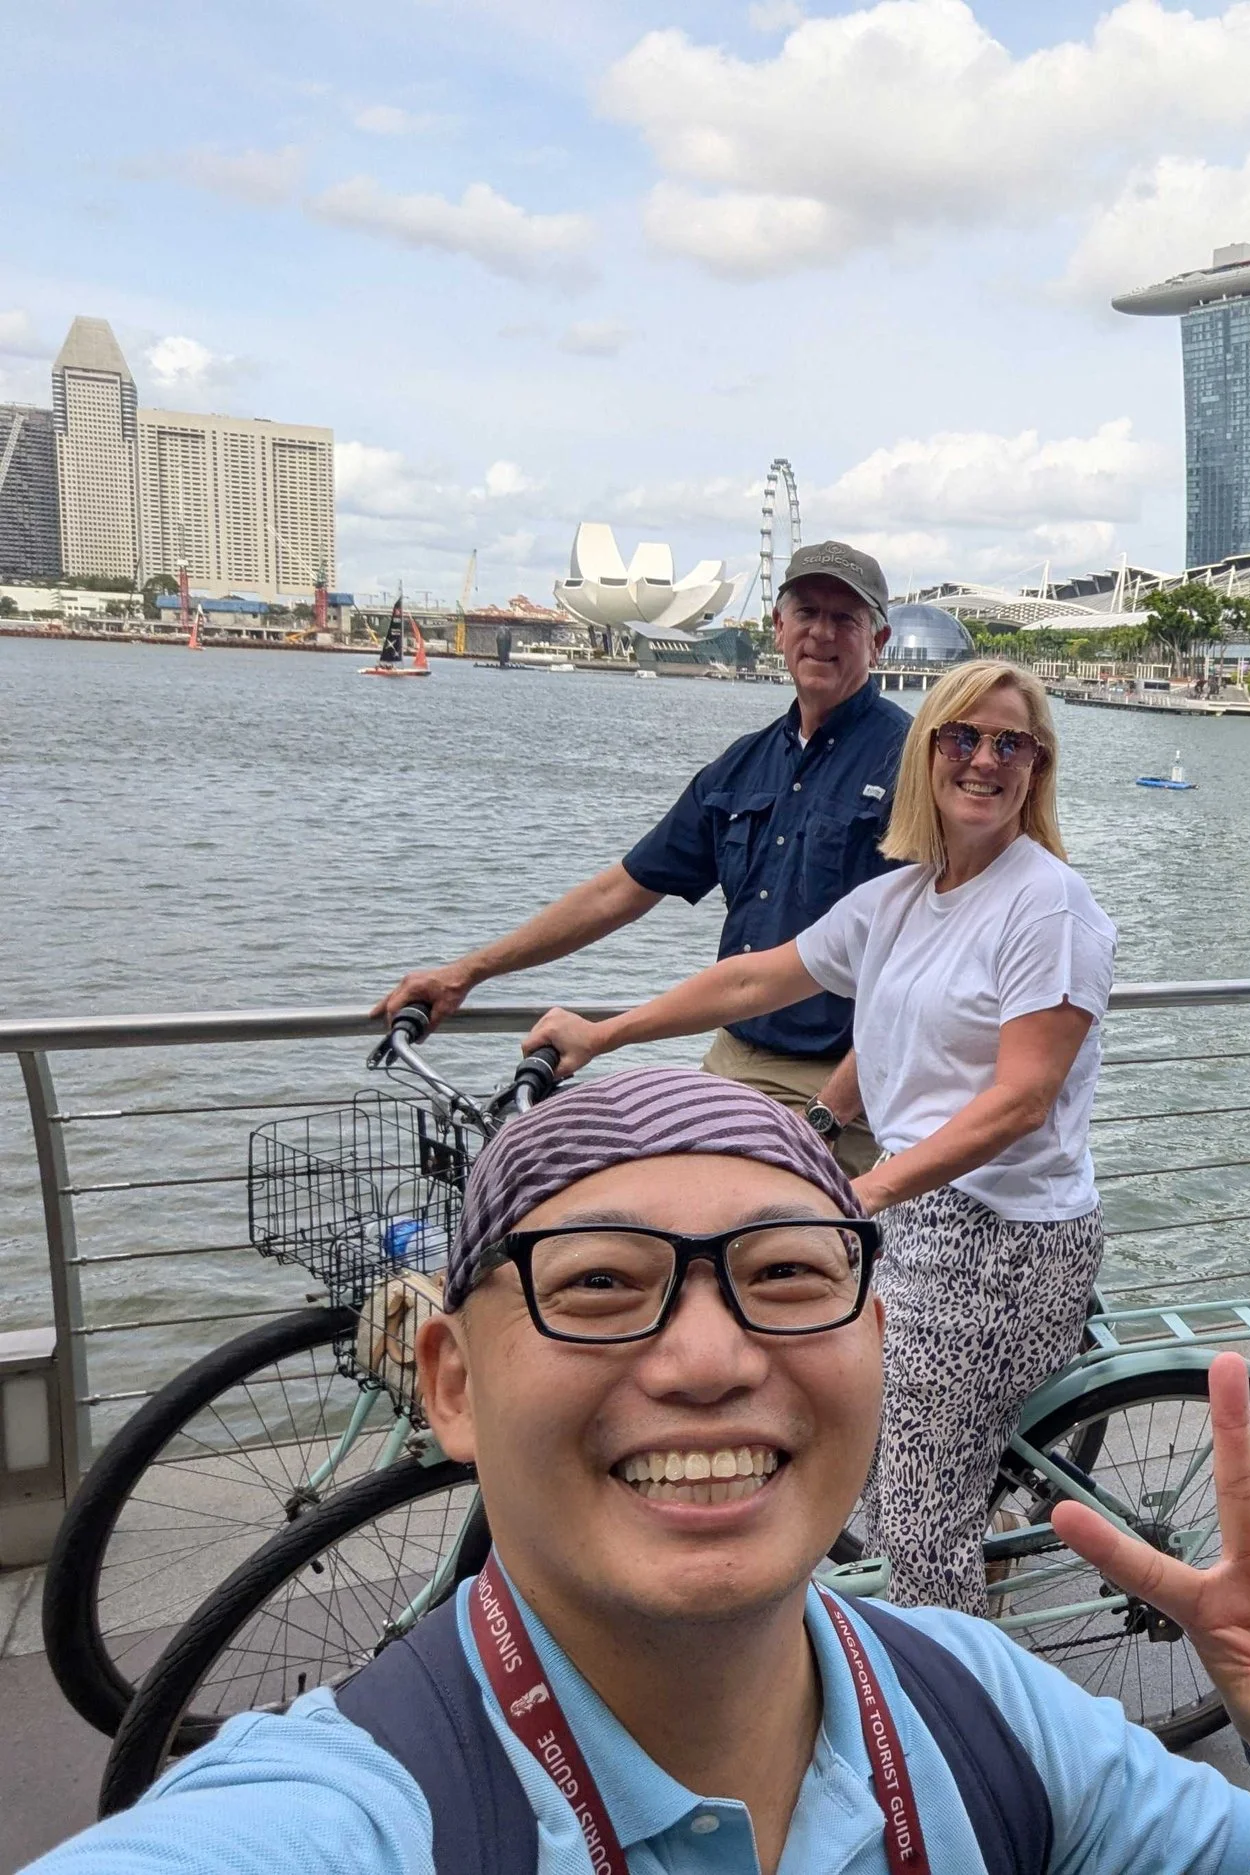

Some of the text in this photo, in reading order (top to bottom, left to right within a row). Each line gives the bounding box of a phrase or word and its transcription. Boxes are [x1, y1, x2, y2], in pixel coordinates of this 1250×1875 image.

[537, 1729, 612, 1875] OURIST GUIDE
[833, 1610, 914, 1862] SINGAPORE TOURIST GUIDE
